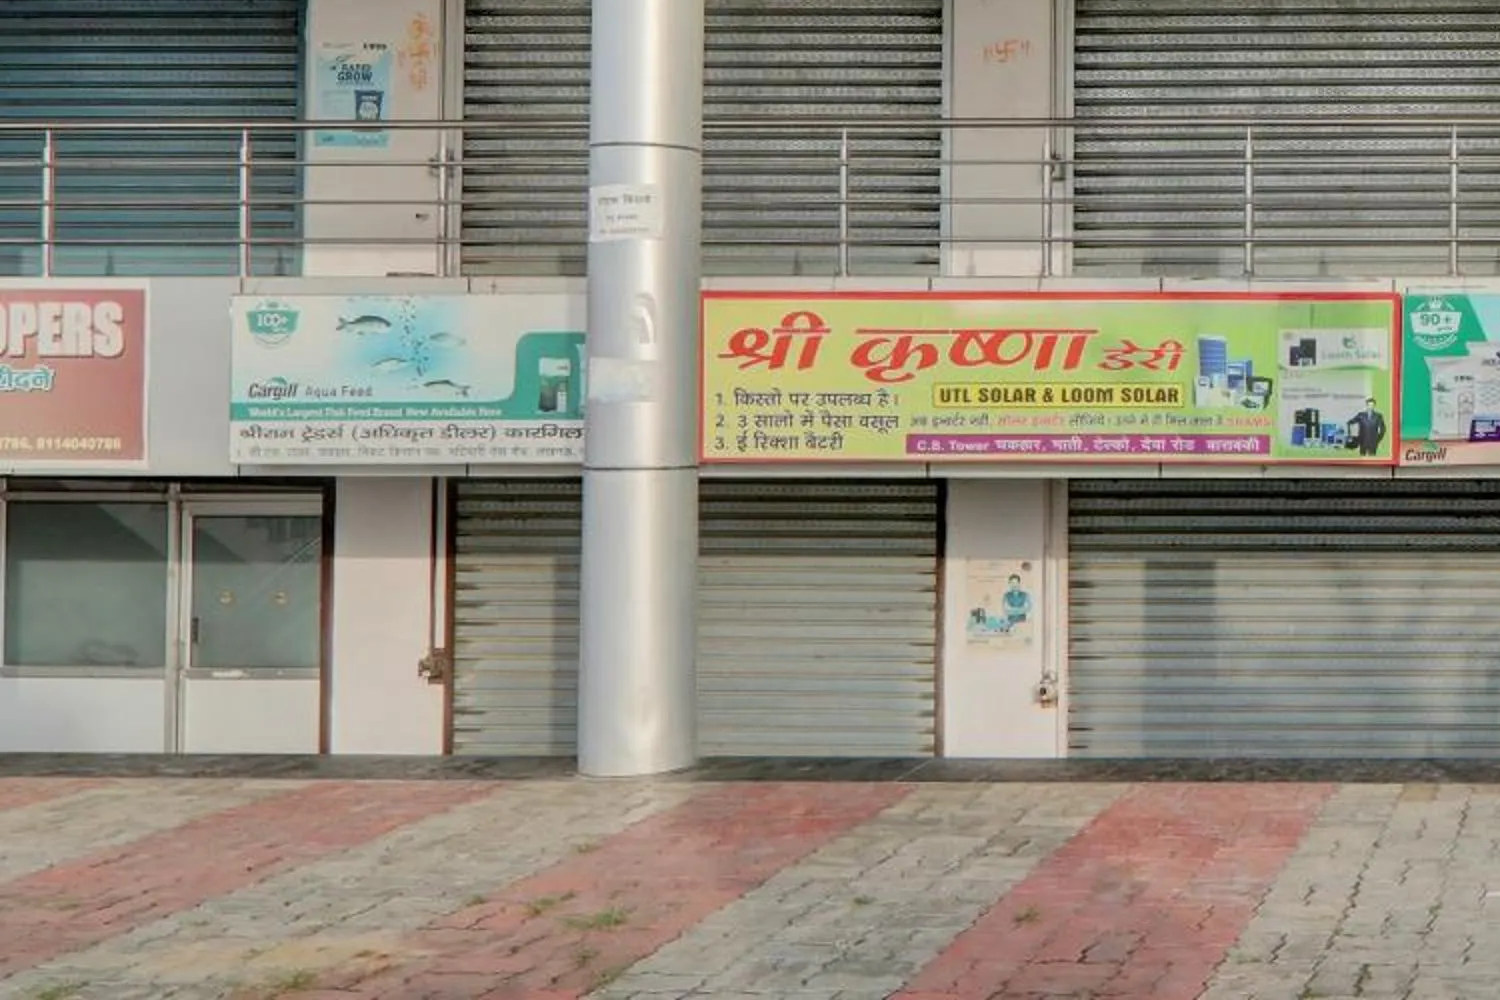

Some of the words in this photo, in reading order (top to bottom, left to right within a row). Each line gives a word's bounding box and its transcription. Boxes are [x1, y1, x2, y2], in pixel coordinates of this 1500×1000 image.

[717, 309, 832, 370] श्री
[248, 382, 298, 401] Cargill
[304, 385, 337, 399] Aqua
[341, 385, 373, 397] Feed
[788, 392, 809, 407] पर
[939, 388, 970, 403] UTL
[977, 387, 1036, 403] SOLAR
[1042, 387, 1054, 403] &
[1061, 387, 1114, 403] LOOM
[1120, 387, 1179, 402] SOLAR
[1405, 447, 1447, 463] Cargill
